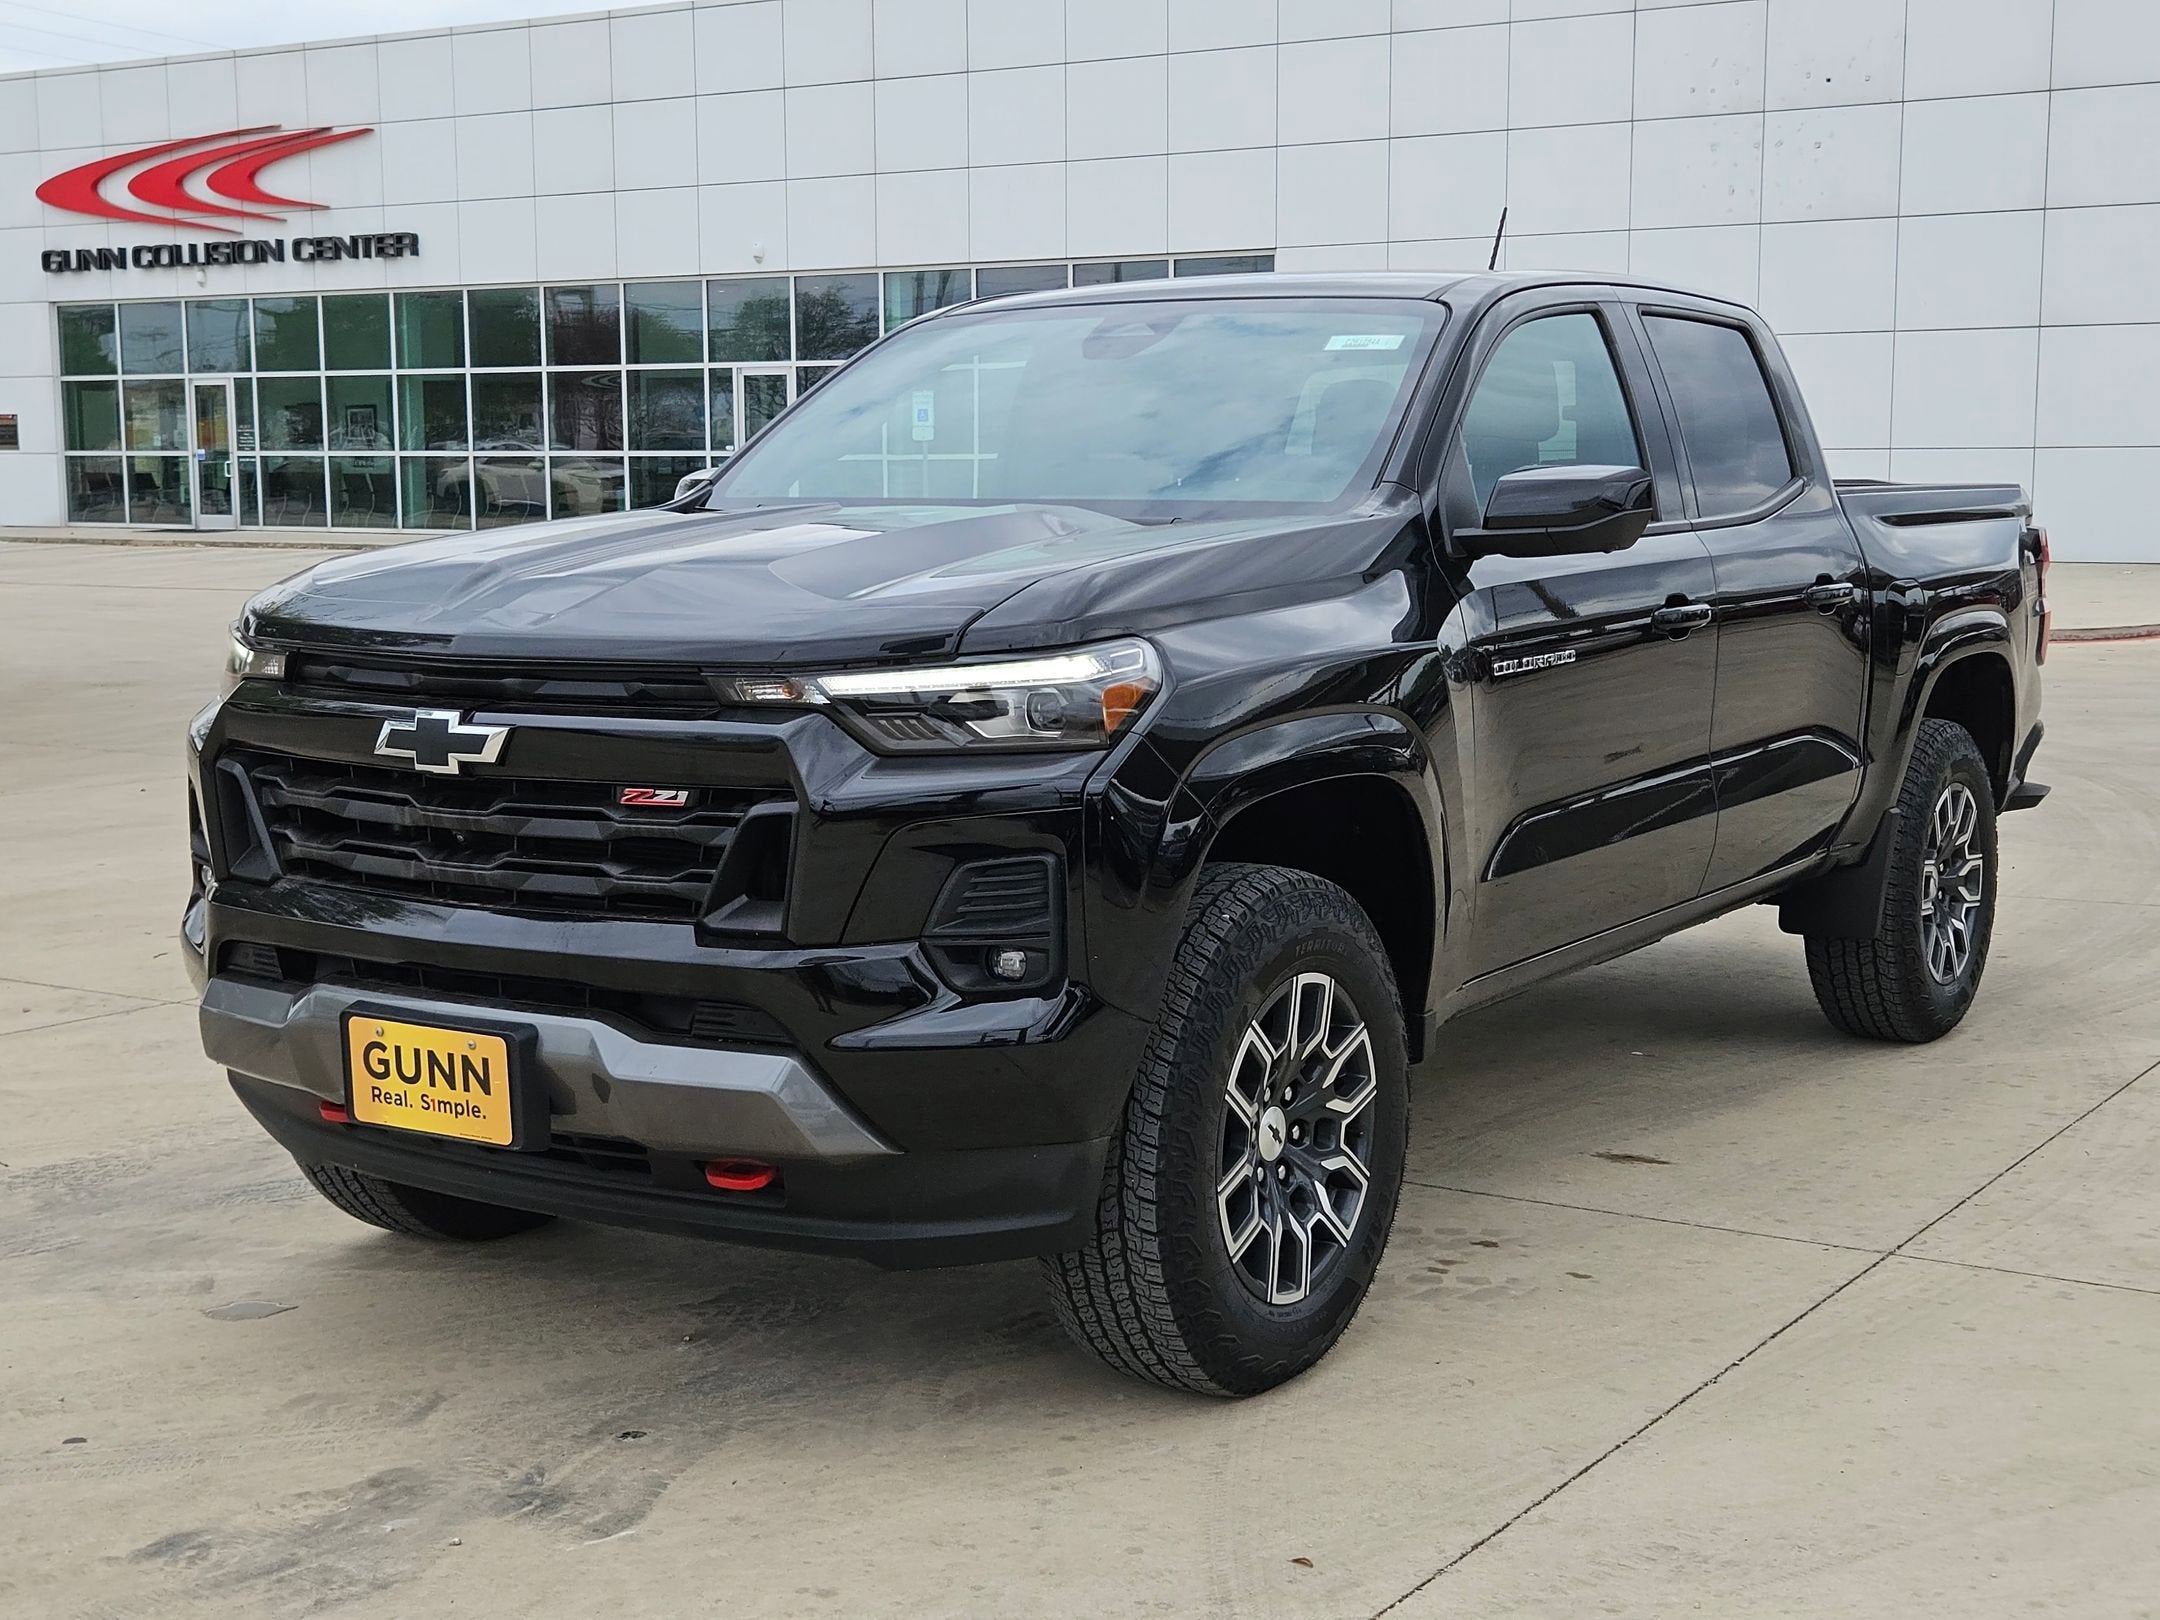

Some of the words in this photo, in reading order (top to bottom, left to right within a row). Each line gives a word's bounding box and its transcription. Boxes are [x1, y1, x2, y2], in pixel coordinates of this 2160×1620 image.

[41, 248, 127, 273] GUNN
[131, 239, 285, 269] COLLISION
[291, 232, 419, 262] CENTER
[1493, 650, 1576, 676] COLORADO
[620, 788, 689, 806] Z71
[362, 1040, 492, 1096] GUNN
[371, 1086, 413, 1108] Real.
